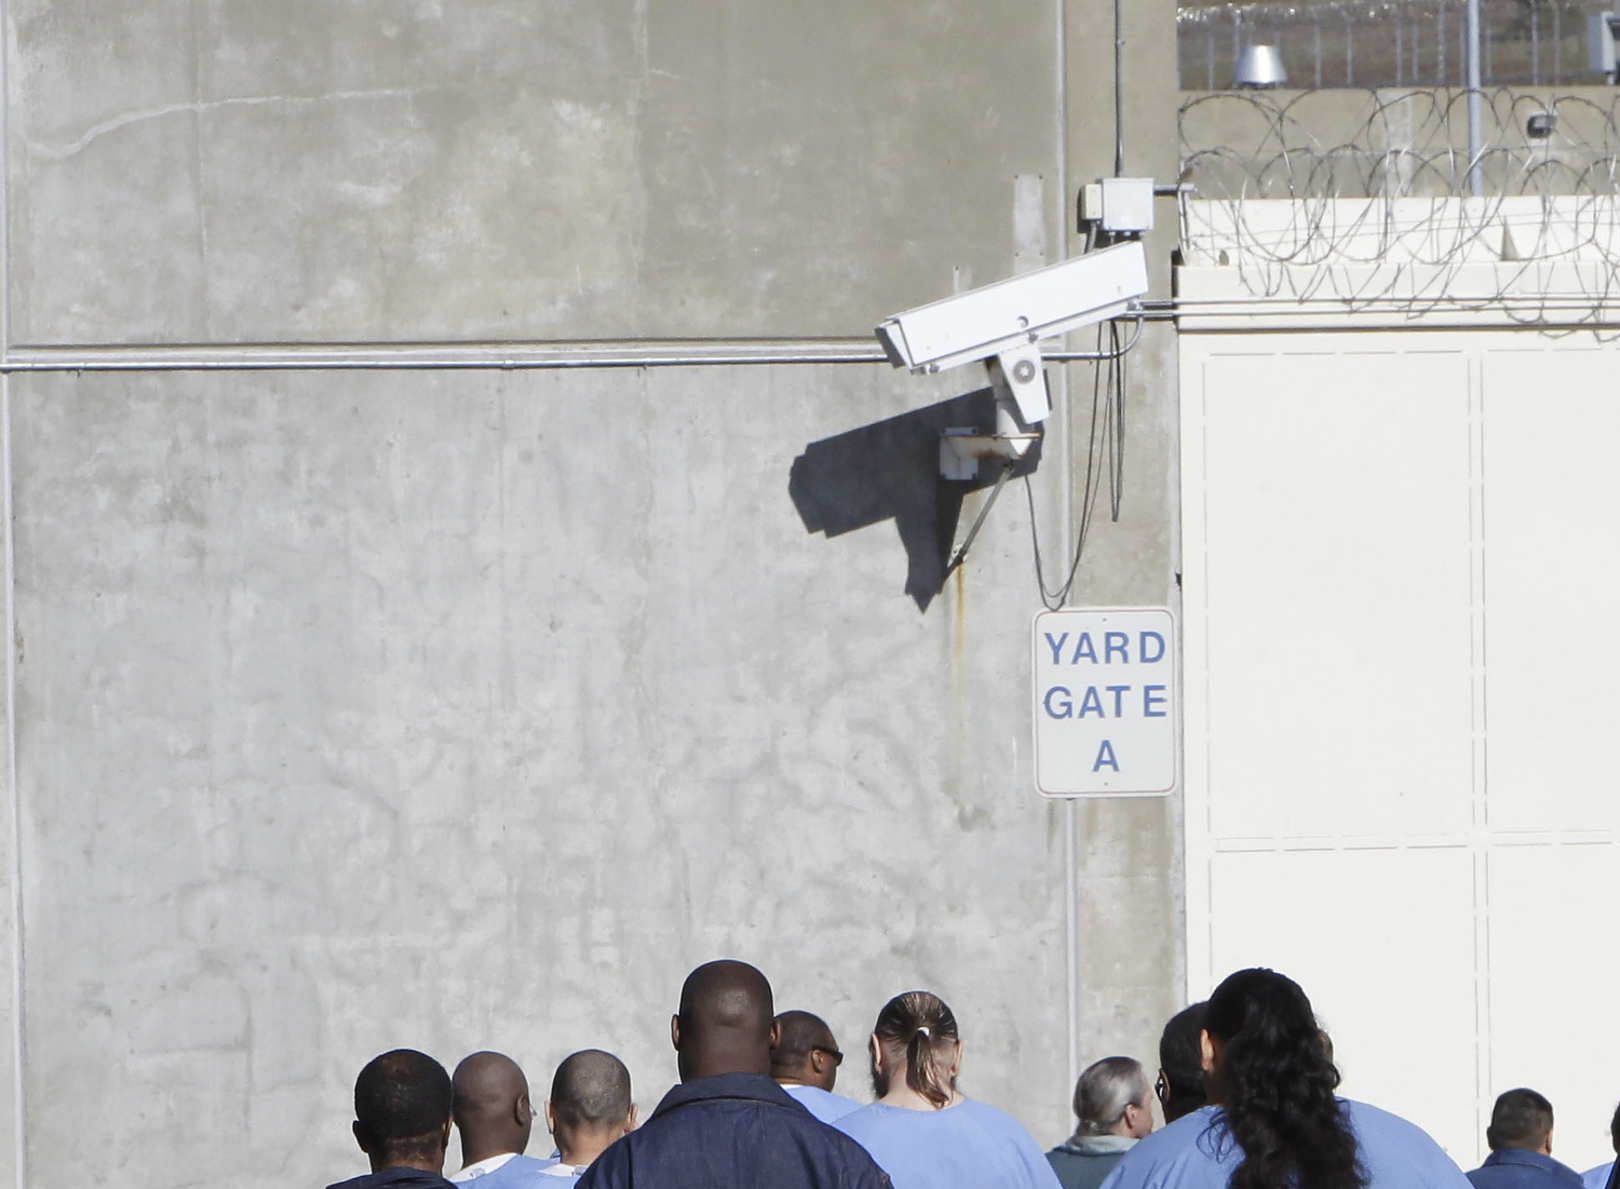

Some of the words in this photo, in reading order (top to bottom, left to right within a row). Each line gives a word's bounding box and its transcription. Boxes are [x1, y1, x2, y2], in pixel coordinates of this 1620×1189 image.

[1043, 631, 1166, 665] YARD
[1043, 684, 1168, 720] GATE
[1092, 739, 1120, 773] A
